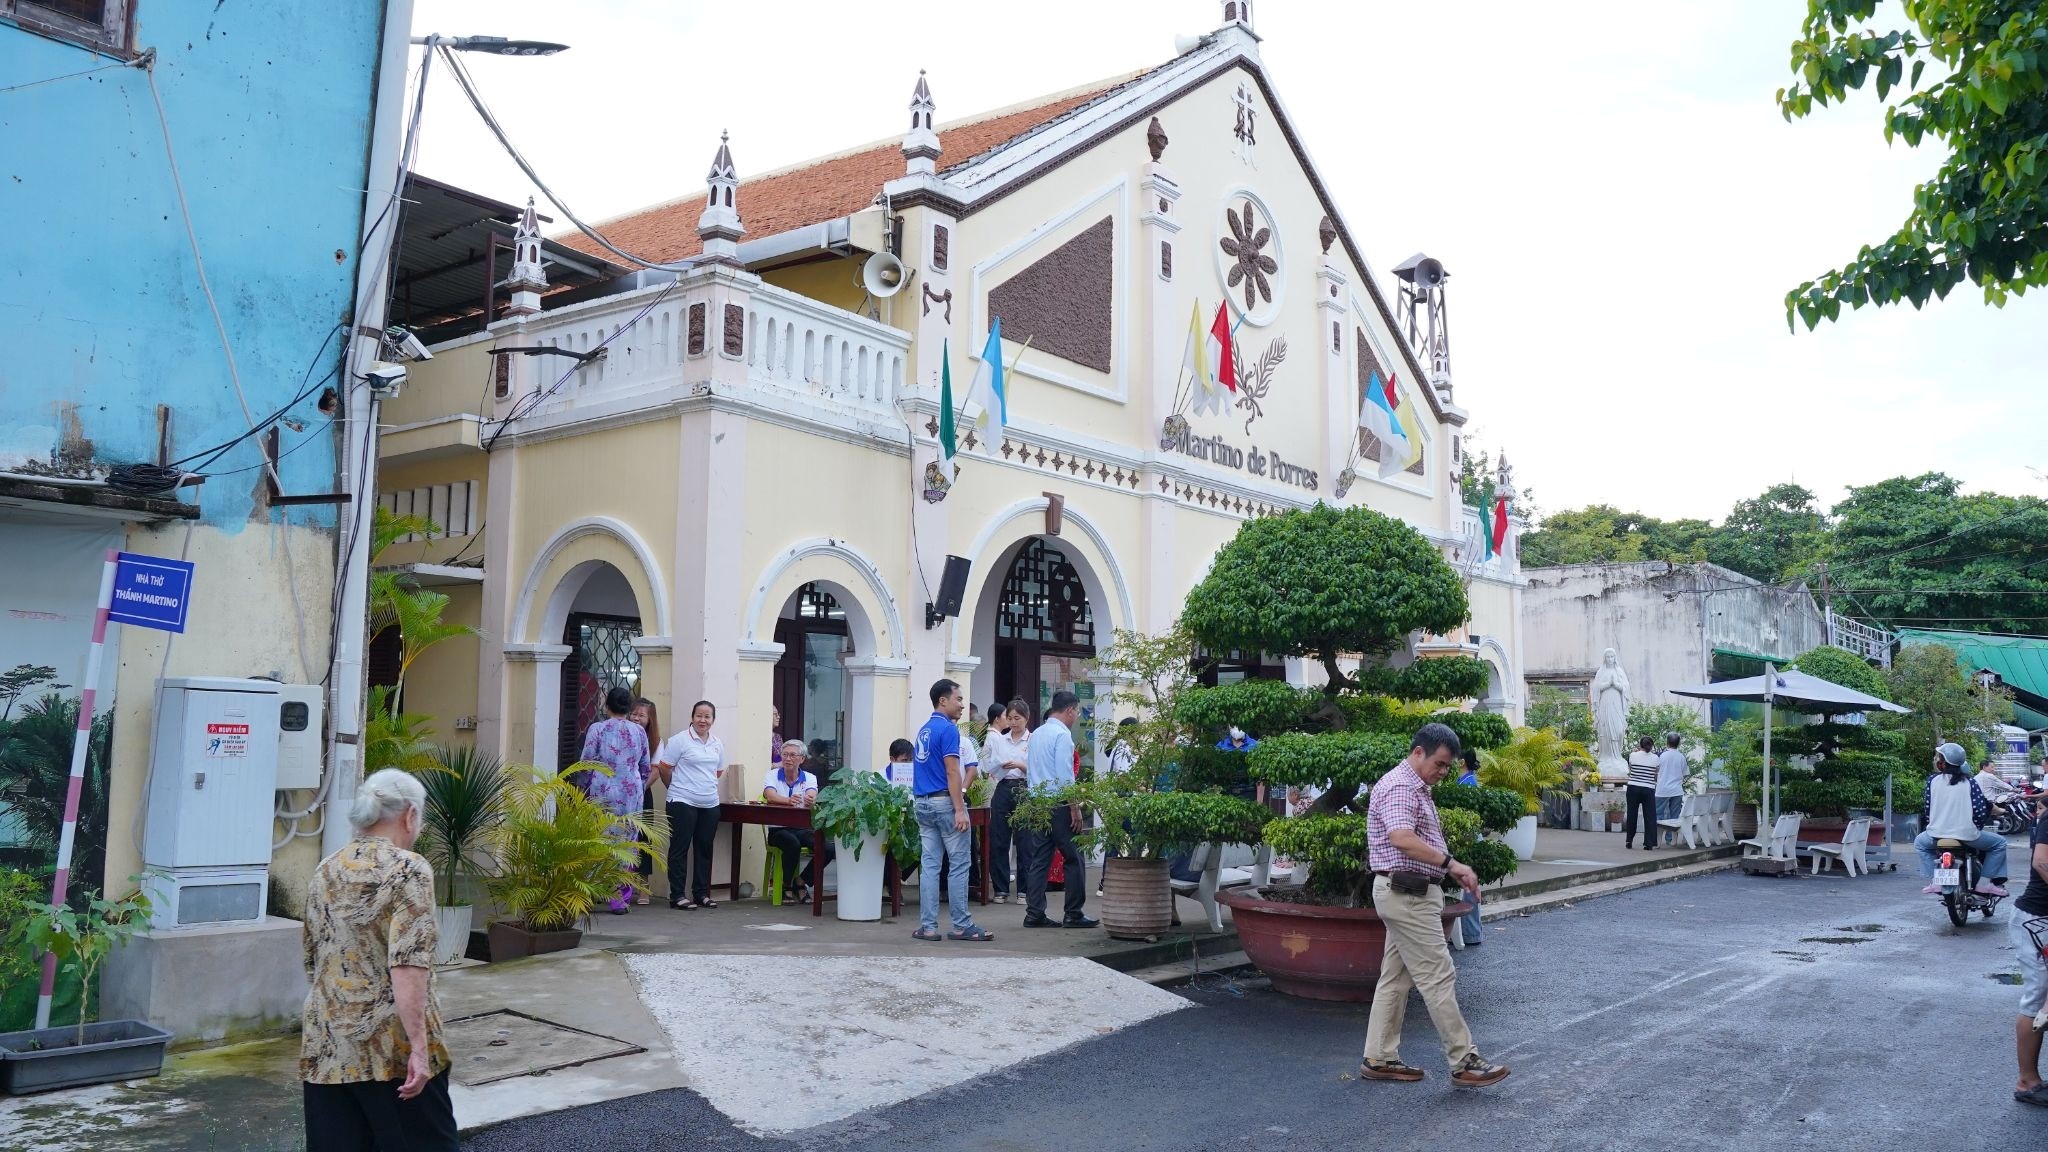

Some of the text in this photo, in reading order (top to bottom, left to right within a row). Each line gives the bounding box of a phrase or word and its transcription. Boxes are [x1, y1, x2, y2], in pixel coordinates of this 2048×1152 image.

[1176, 426, 1319, 491] Martino de Porres
[136, 573, 165, 587] NHÀ THỜ
[115, 587, 178, 608] THÁNH MARTINO
